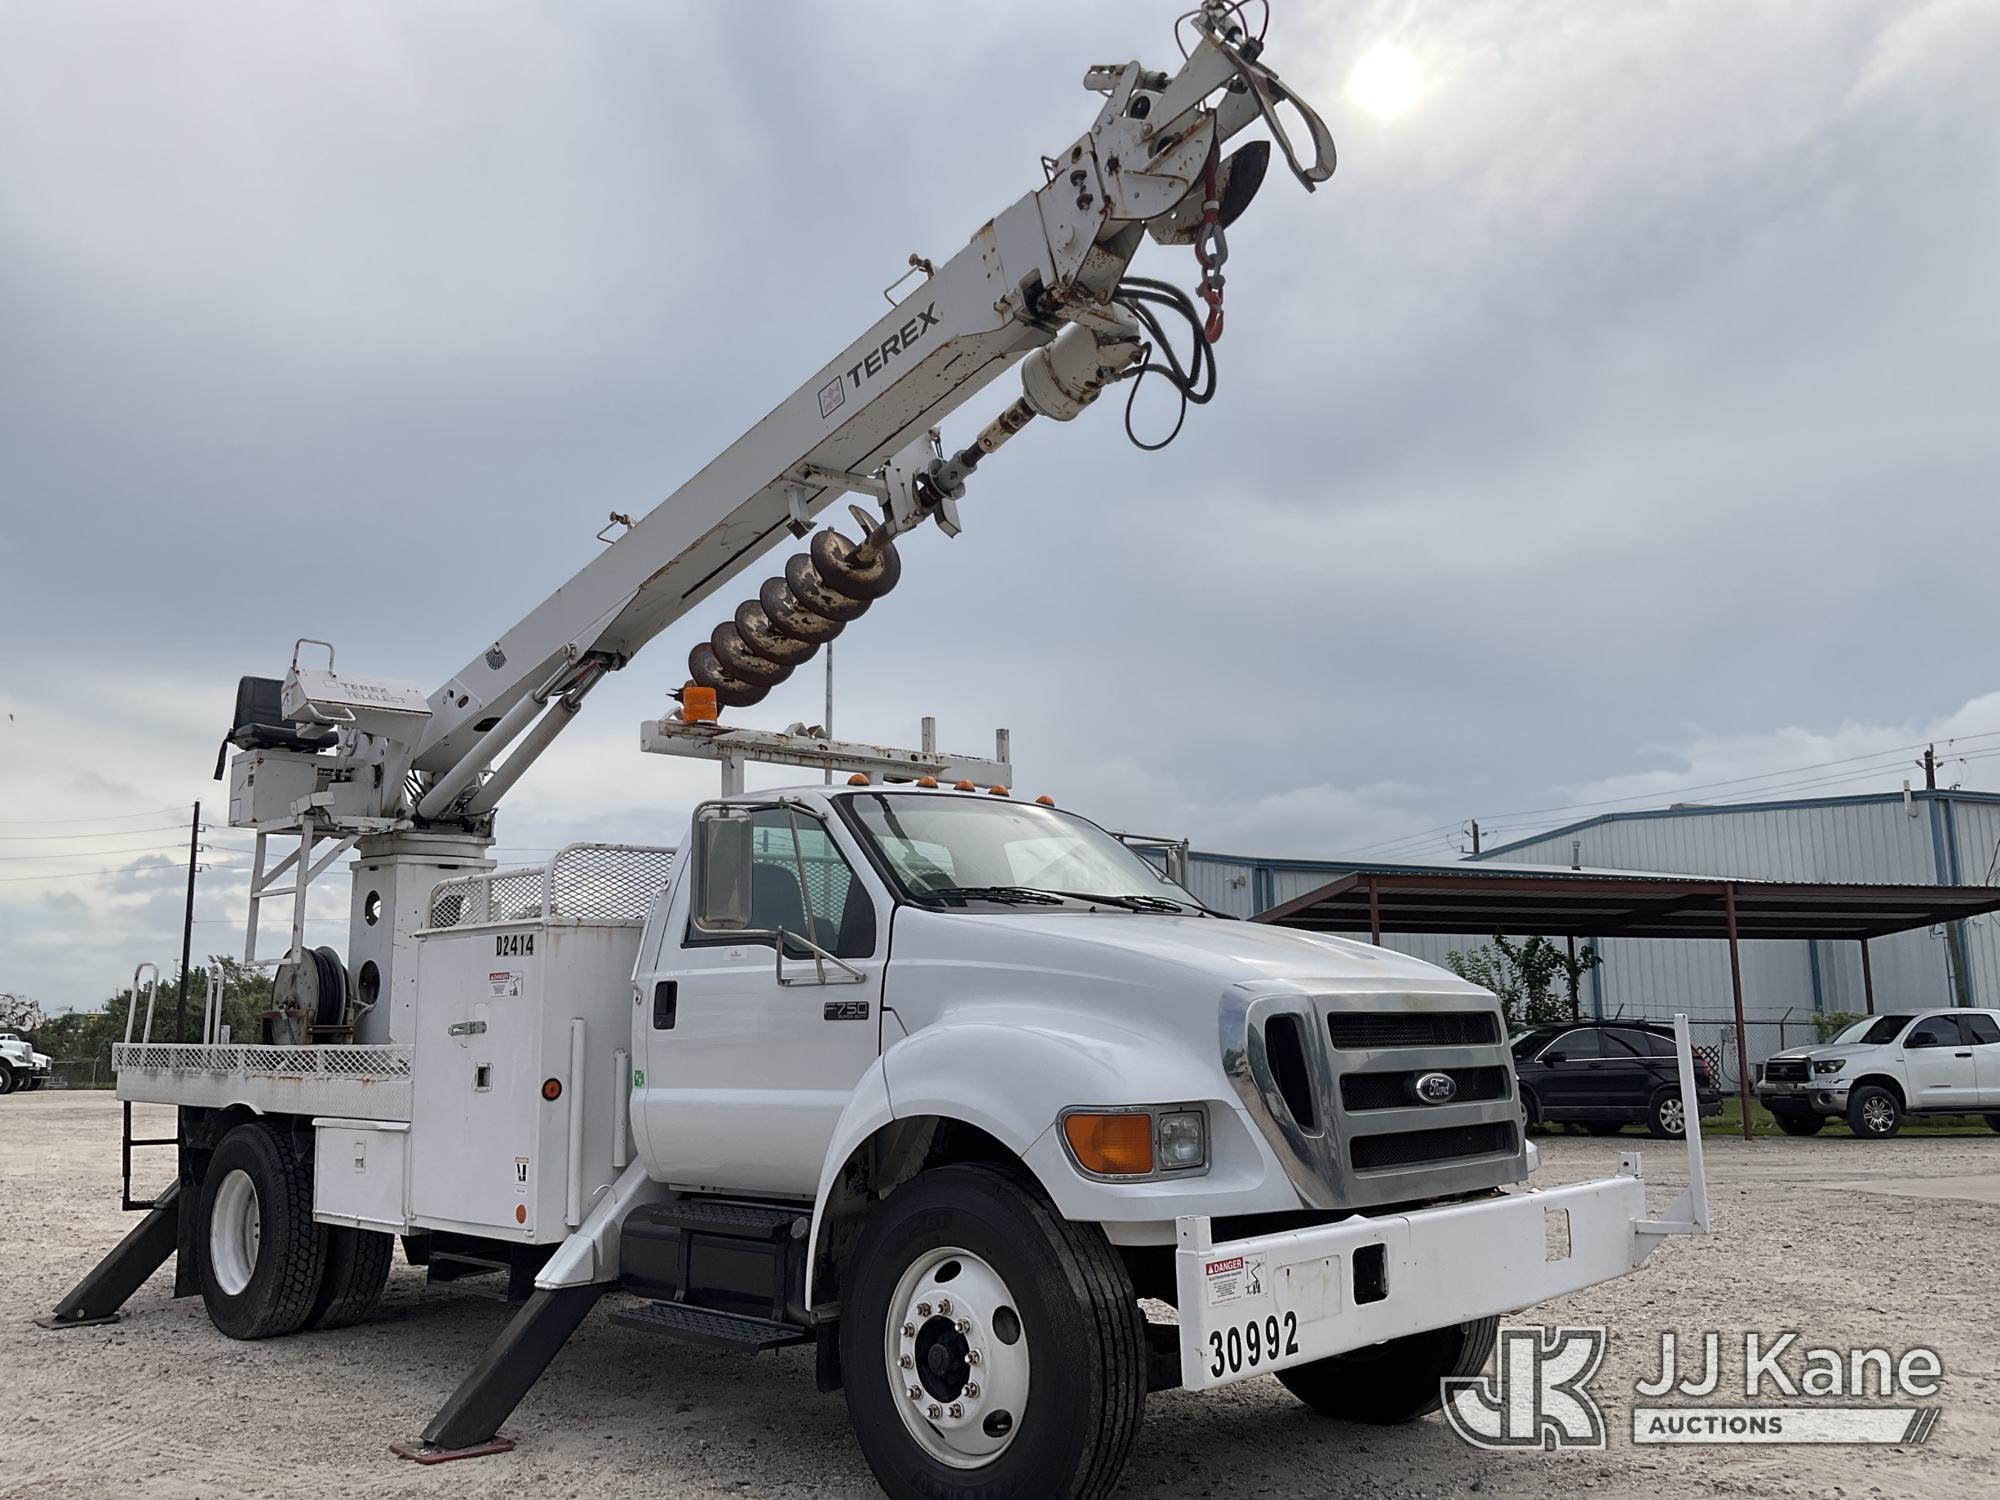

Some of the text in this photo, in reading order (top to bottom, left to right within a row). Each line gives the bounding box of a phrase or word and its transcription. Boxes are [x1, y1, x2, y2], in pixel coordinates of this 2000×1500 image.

[847, 301, 940, 388] TEREX
[341, 682, 388, 694] TEREX
[496, 934, 534, 956] D2414
[1429, 1078, 1450, 1096] Ford
[1213, 1259, 1242, 1273] DANGER
[1209, 1311, 1299, 1378] 30992
